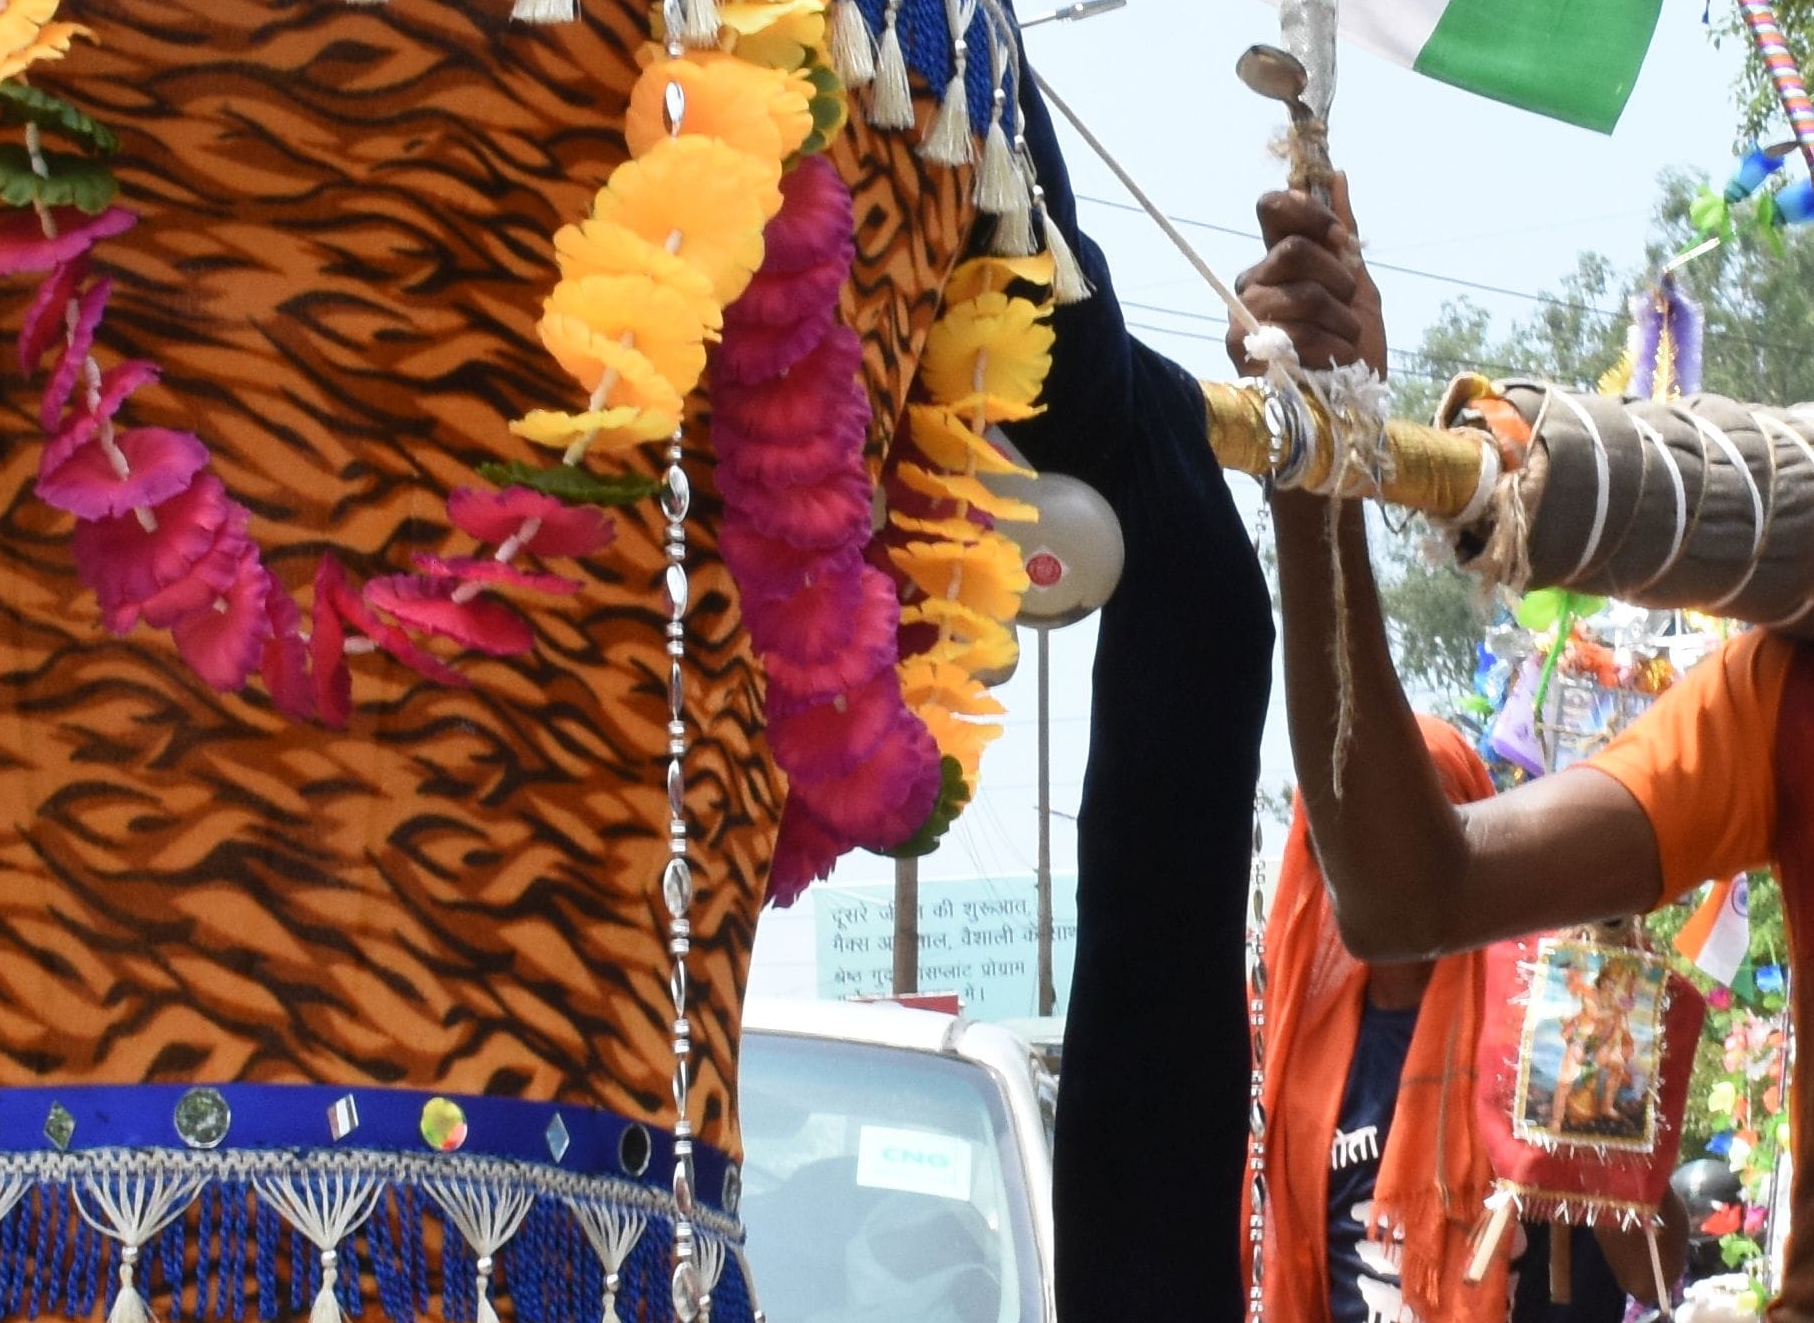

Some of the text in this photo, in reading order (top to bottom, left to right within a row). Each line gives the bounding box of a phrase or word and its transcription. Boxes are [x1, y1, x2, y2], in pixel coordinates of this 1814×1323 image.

[831, 900, 868, 933] दूसरे
[933, 898, 953, 920] की
[961, 923, 1015, 949] वैशाली
[882, 1146, 950, 1169] CNG
